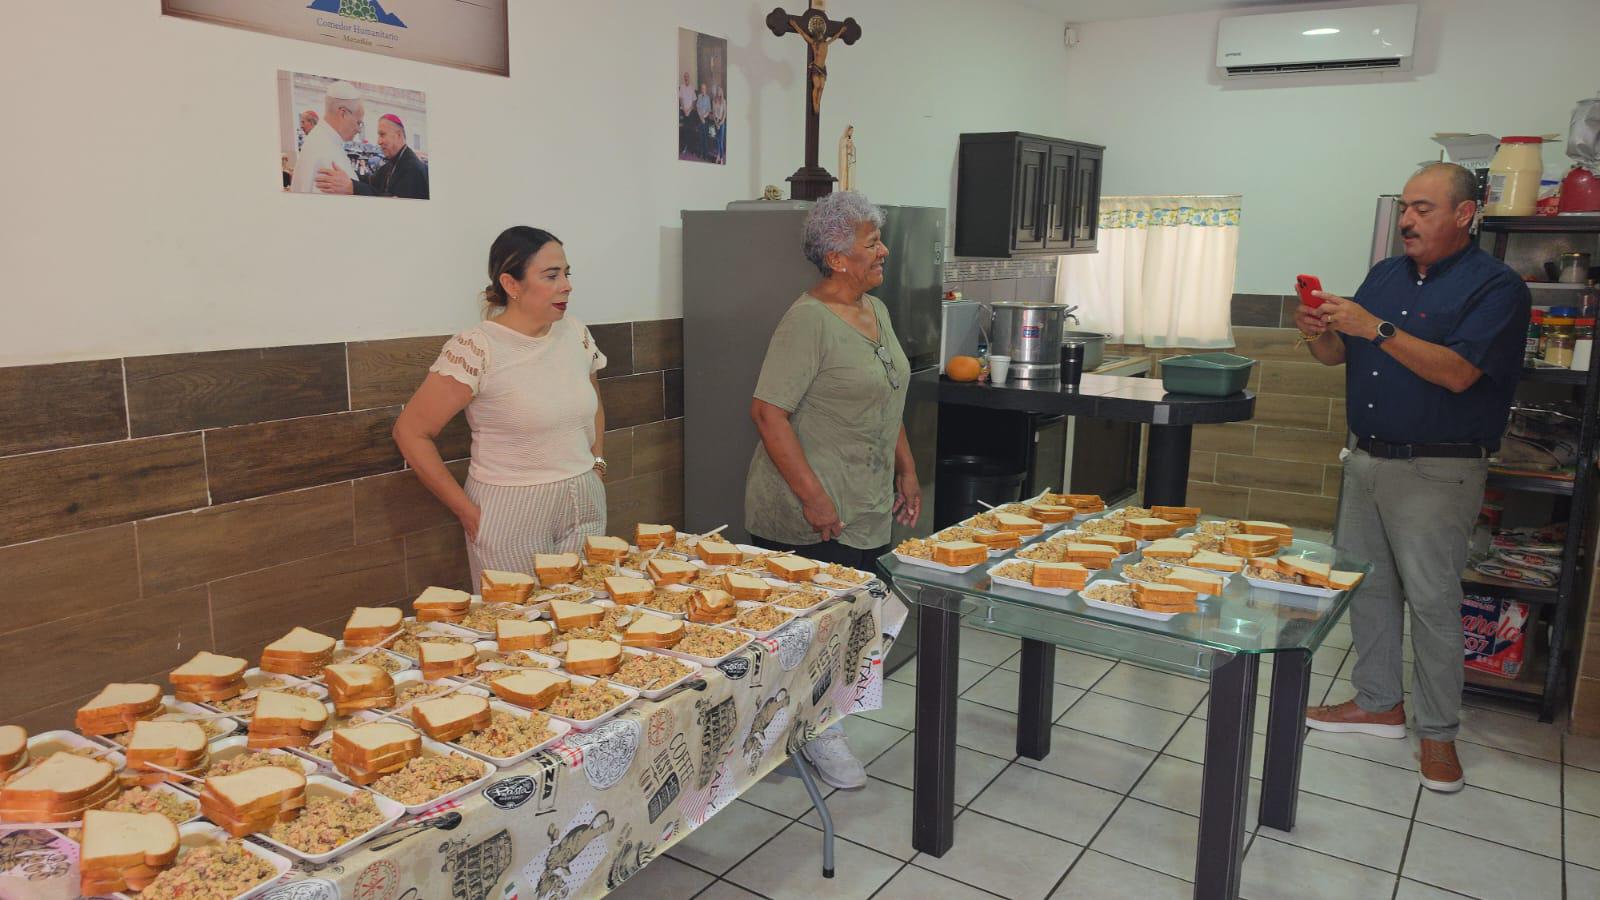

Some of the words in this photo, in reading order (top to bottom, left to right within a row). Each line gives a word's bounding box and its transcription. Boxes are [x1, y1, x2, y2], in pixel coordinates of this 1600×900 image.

[316, 17, 352, 32] Comedor
[353, 24, 399, 41] Humanitario
[669, 732, 694, 786] COFFEE
